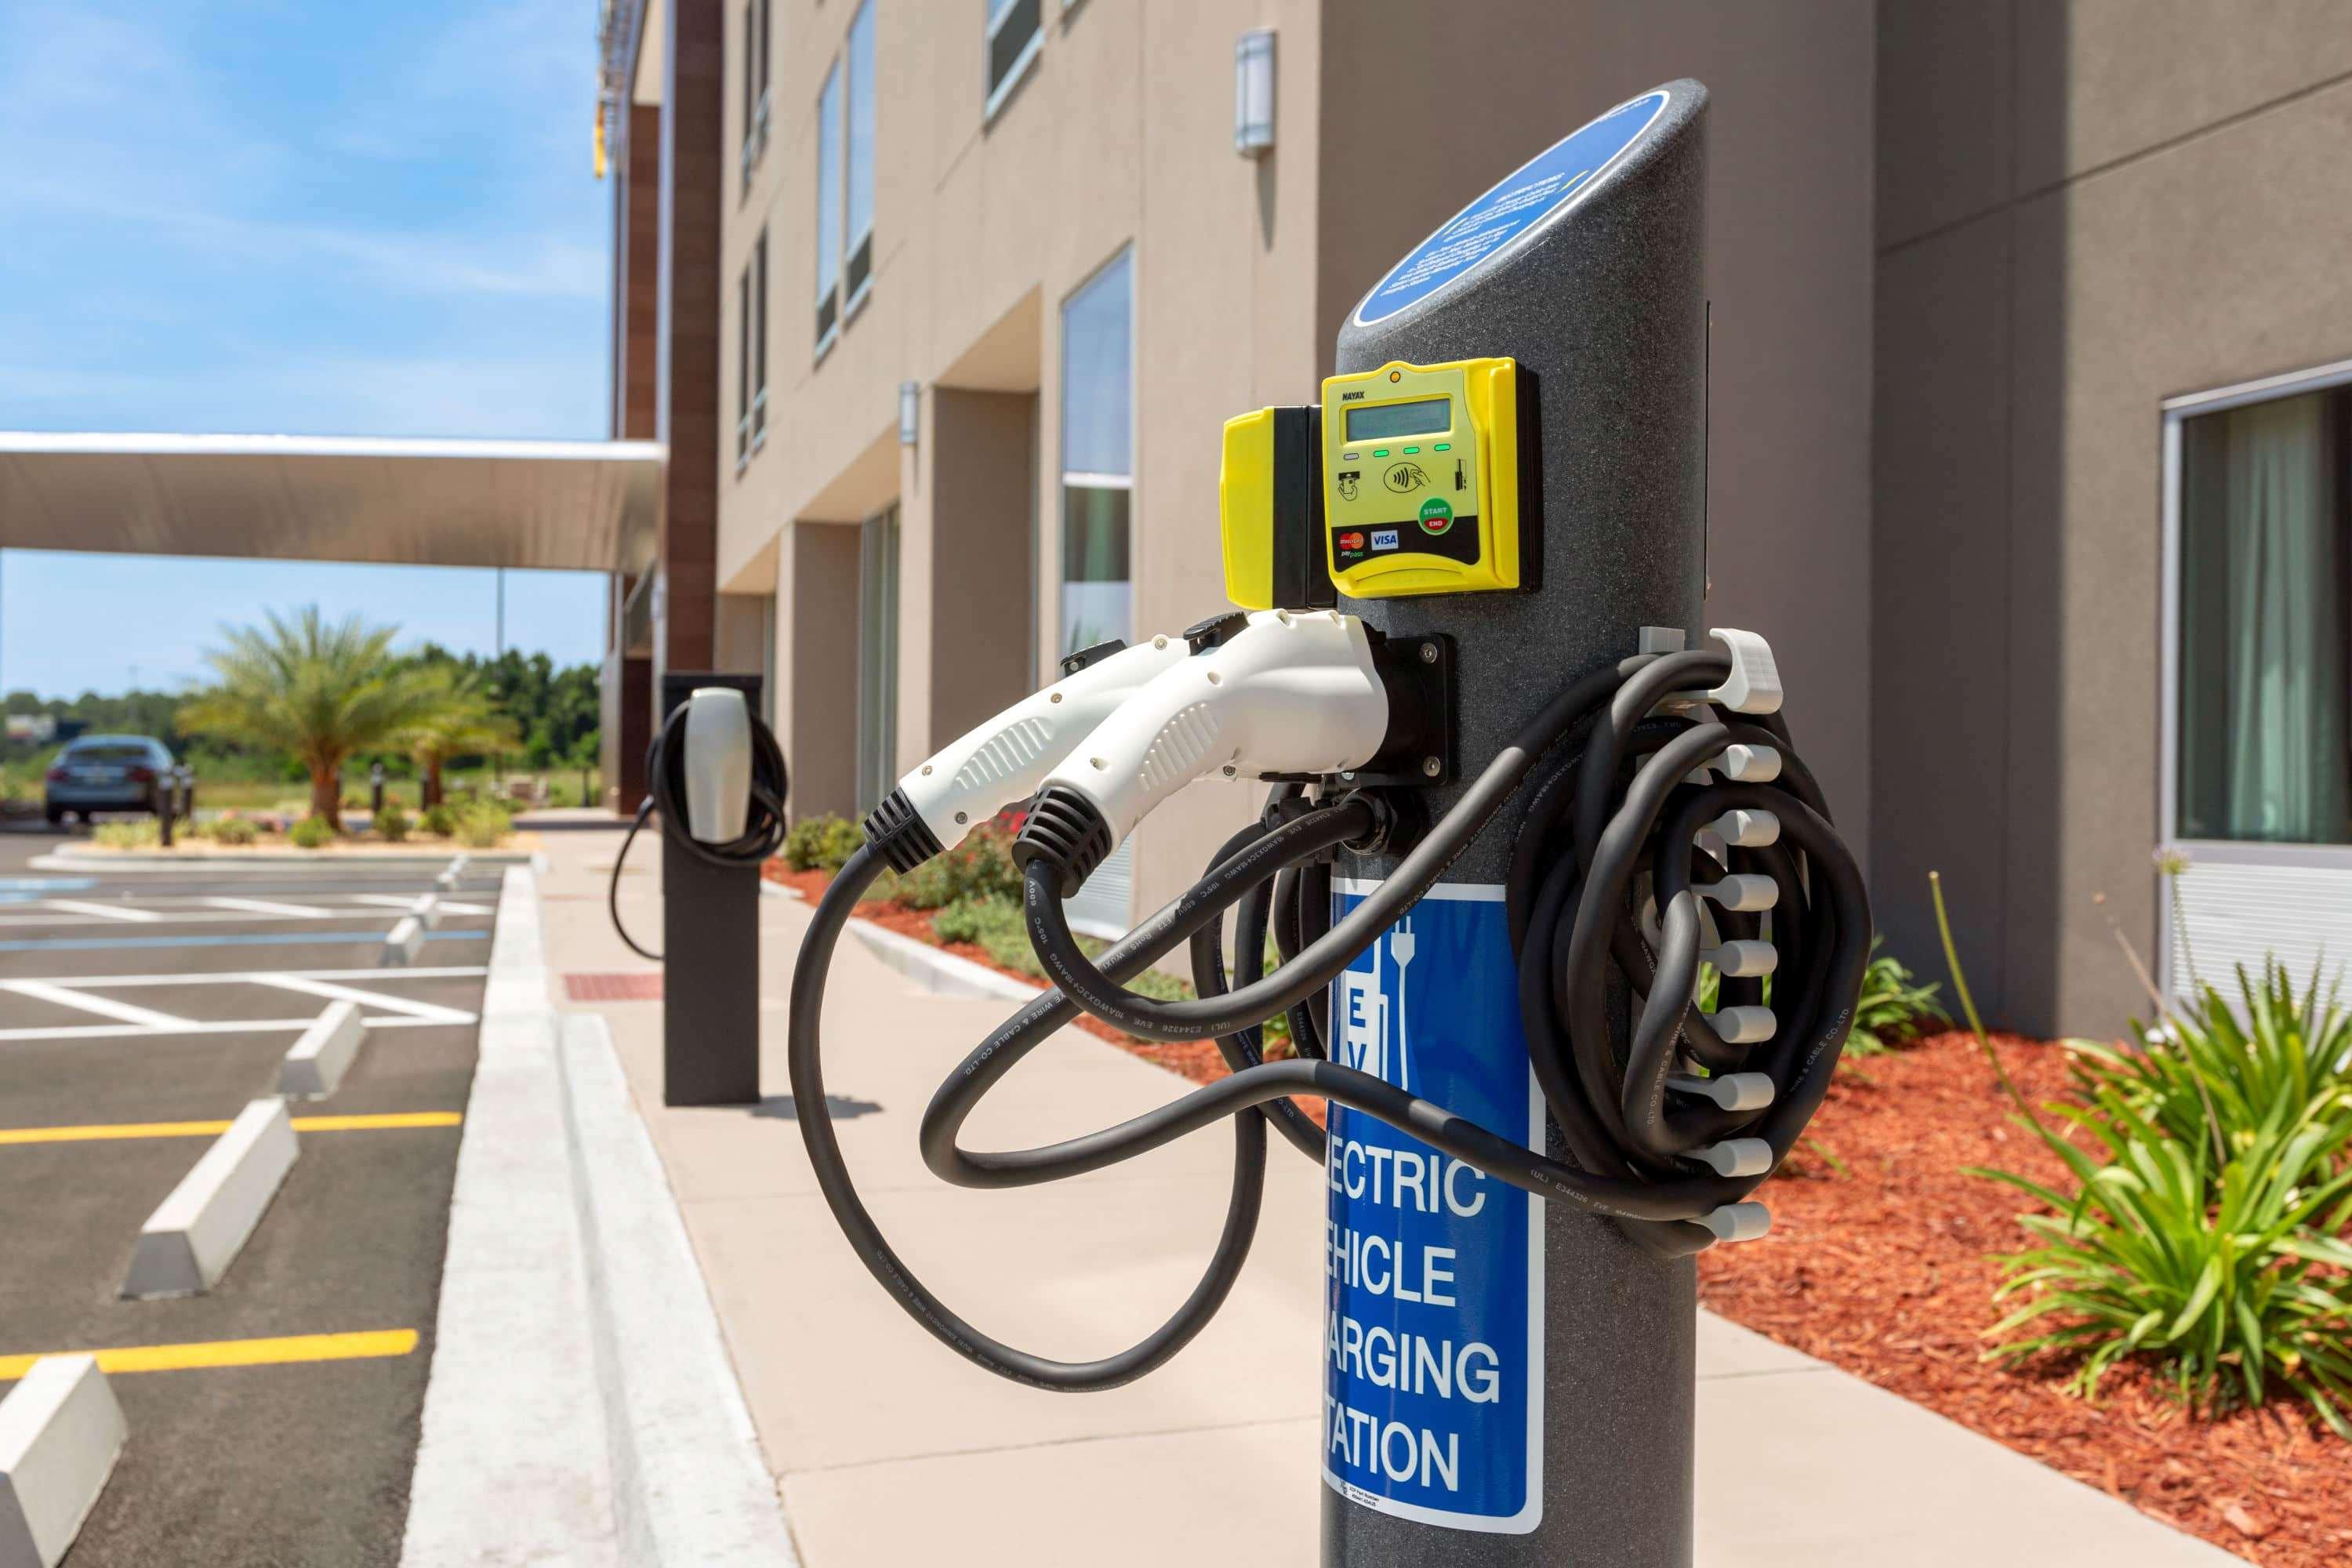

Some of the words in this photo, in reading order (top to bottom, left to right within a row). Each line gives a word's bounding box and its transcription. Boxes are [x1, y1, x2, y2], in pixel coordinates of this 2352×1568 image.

[1342, 390, 1364, 401] NAYAX
[1424, 506, 1447, 515] START
[1374, 535, 1397, 546] VISA
[1031, 1001, 1053, 1019] WIRE
[994, 1025, 1022, 1049] CABLE
[1806, 1040, 1827, 1065] CABLE
[1653, 1060, 1668, 1091] CABLE
[1327, 1134, 1486, 1218] ECTRIC
[1327, 1218, 1456, 1308] EHICLE
[1326, 1309, 1500, 1403] ARGING
[1325, 1393, 1459, 1492] TATION
